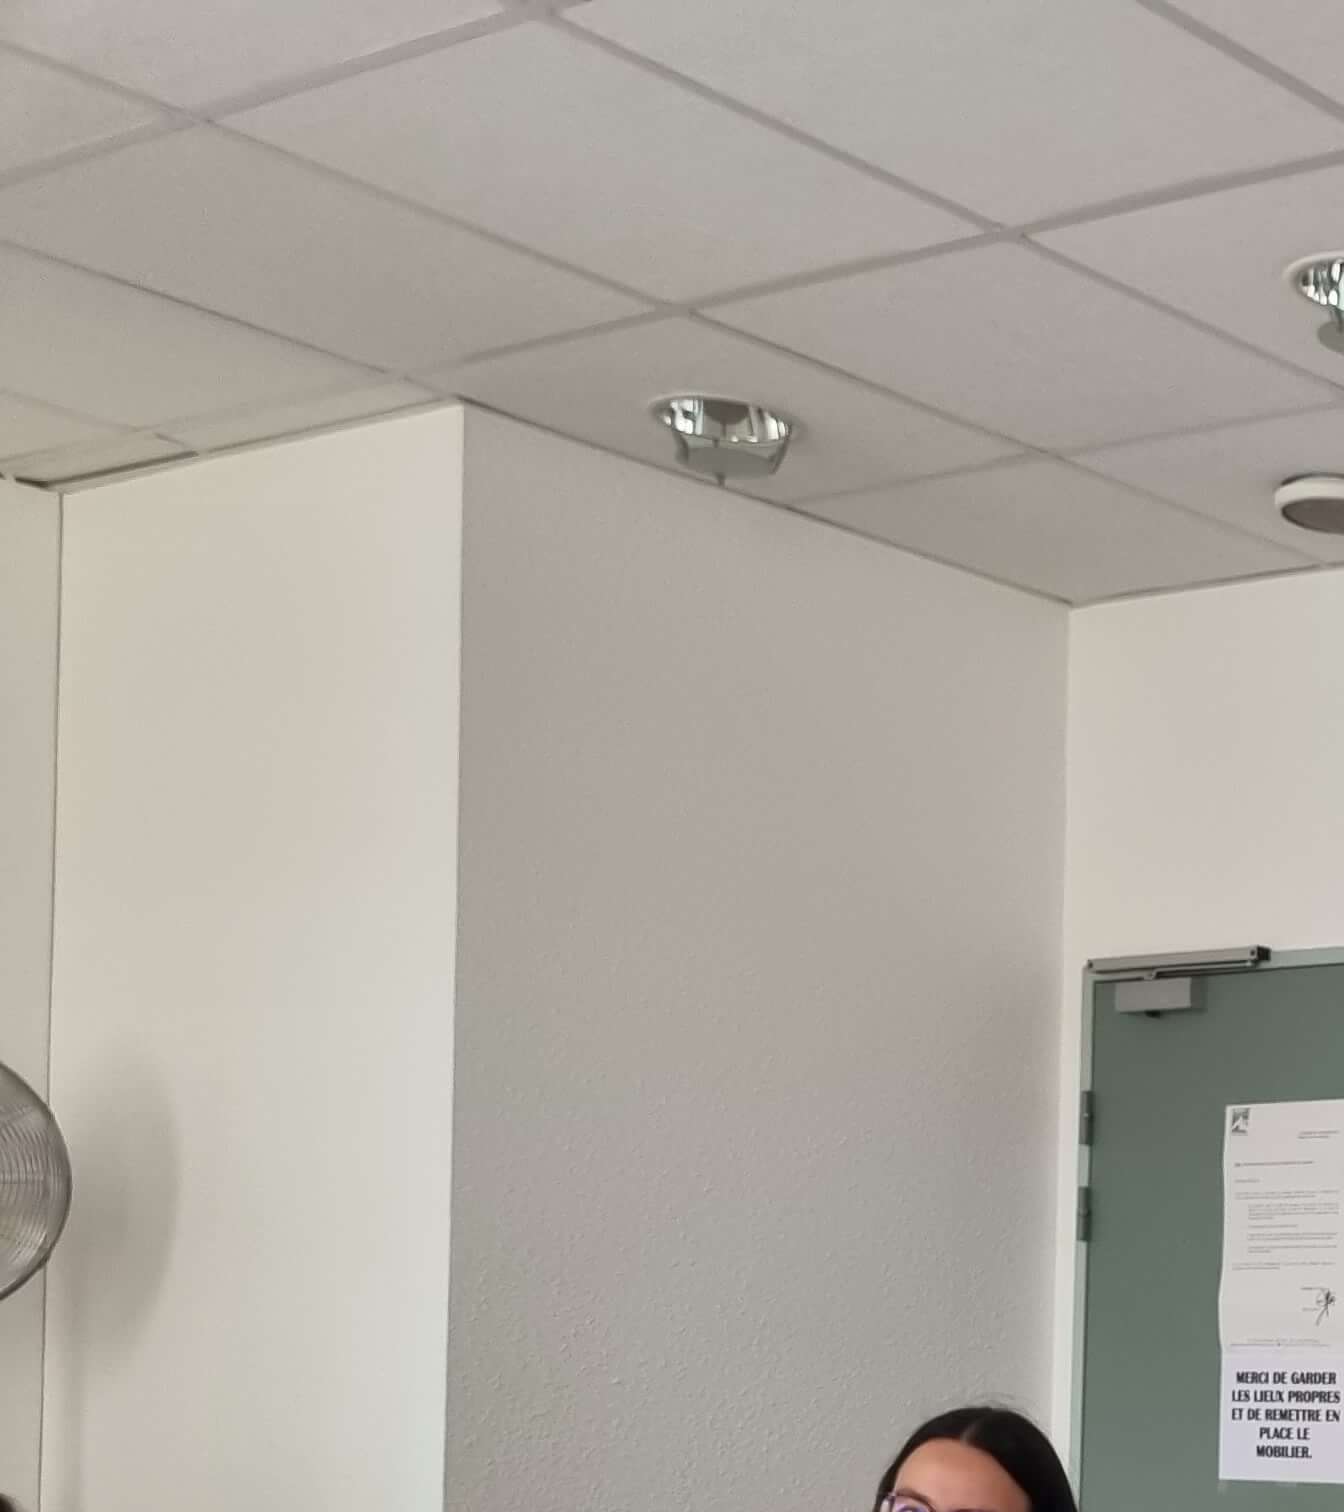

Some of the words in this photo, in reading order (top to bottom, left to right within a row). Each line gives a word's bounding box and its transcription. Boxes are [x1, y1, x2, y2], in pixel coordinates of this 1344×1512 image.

[1236, 1371, 1269, 1384] MERCI
[1273, 1371, 1287, 1384] DE
[1291, 1371, 1336, 1385] GARDER
[1232, 1389, 1250, 1402] LES
[1254, 1389, 1284, 1402] LIEUX
[1288, 1390, 1341, 1403] PROPRES
[1232, 1408, 1243, 1420] ET
[1247, 1408, 1260, 1420] DE
[1265, 1408, 1321, 1422] REMETTRE
[1326, 1409, 1340, 1422] EN
[1259, 1427, 1292, 1440] PLACE
[1297, 1427, 1310, 1440] LE
[1256, 1445, 1312, 1459] MOBILIER.
